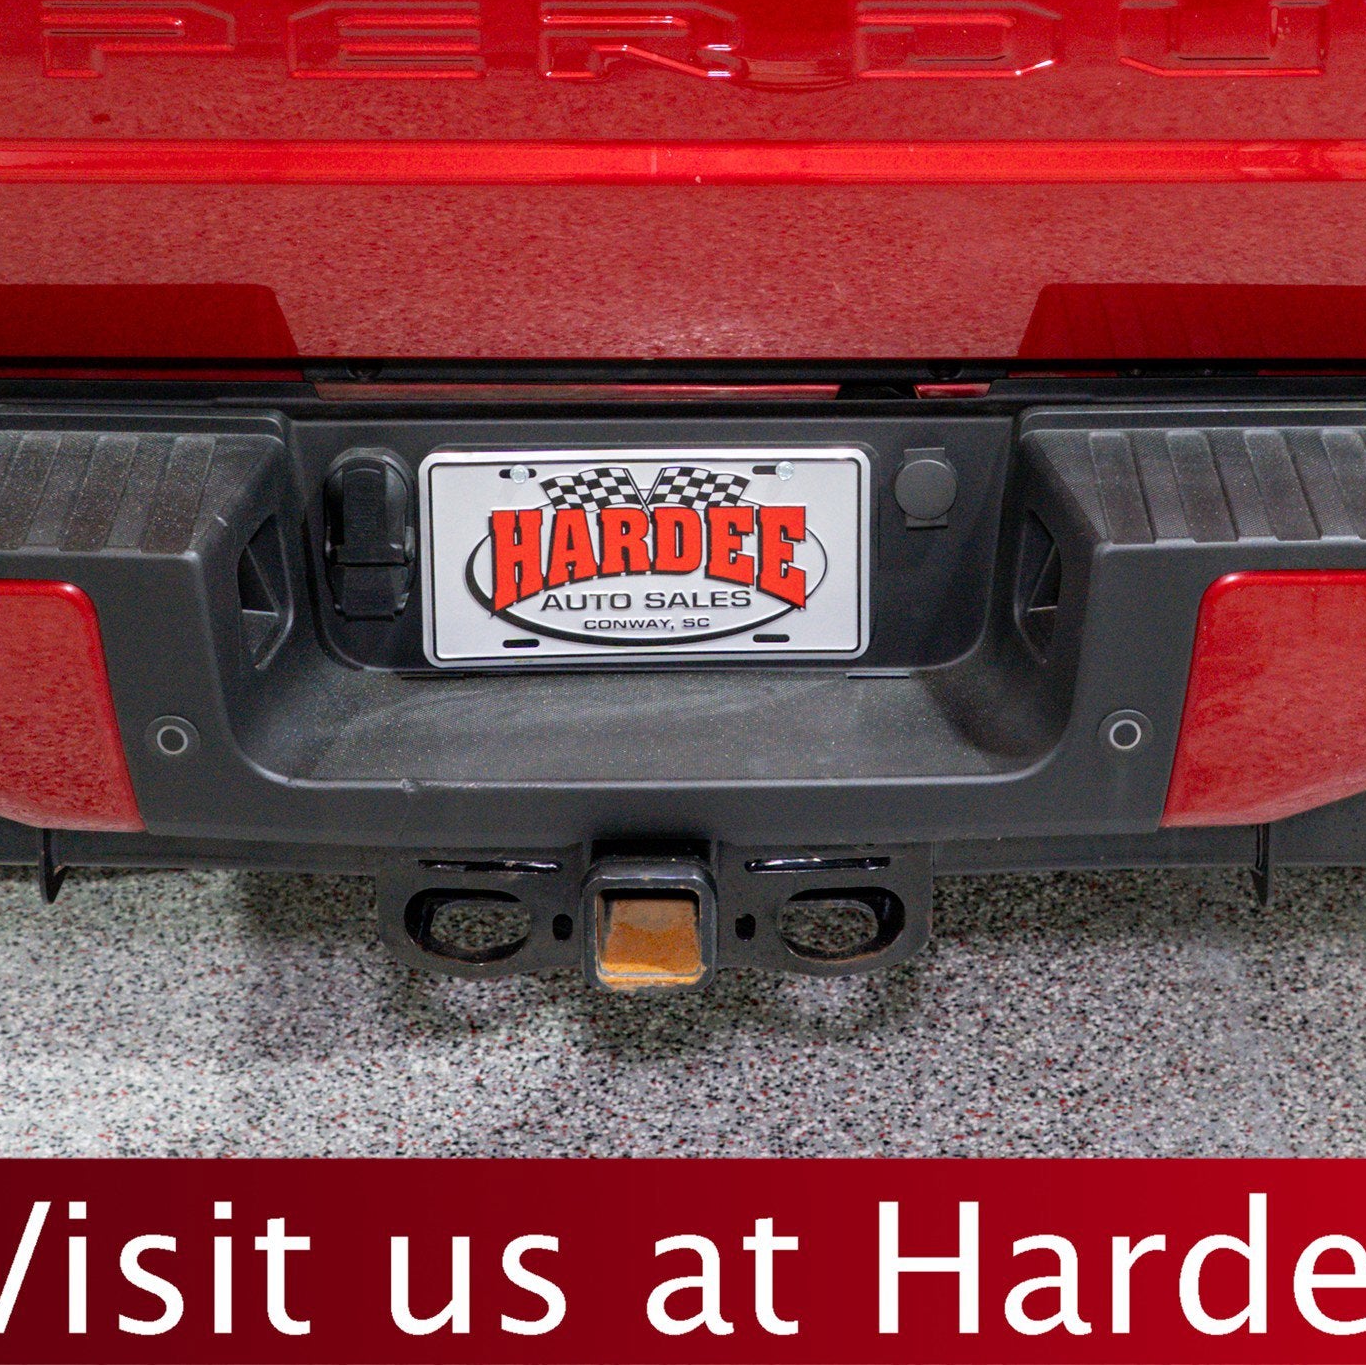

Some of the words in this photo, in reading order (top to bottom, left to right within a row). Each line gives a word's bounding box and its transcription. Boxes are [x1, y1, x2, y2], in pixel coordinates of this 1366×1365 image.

[489, 504, 807, 615] HARDEE
[540, 592, 632, 612] AUTO
[644, 589, 751, 609] SALES
[584, 618, 675, 631] CONWAY,
[682, 617, 711, 628] SC
